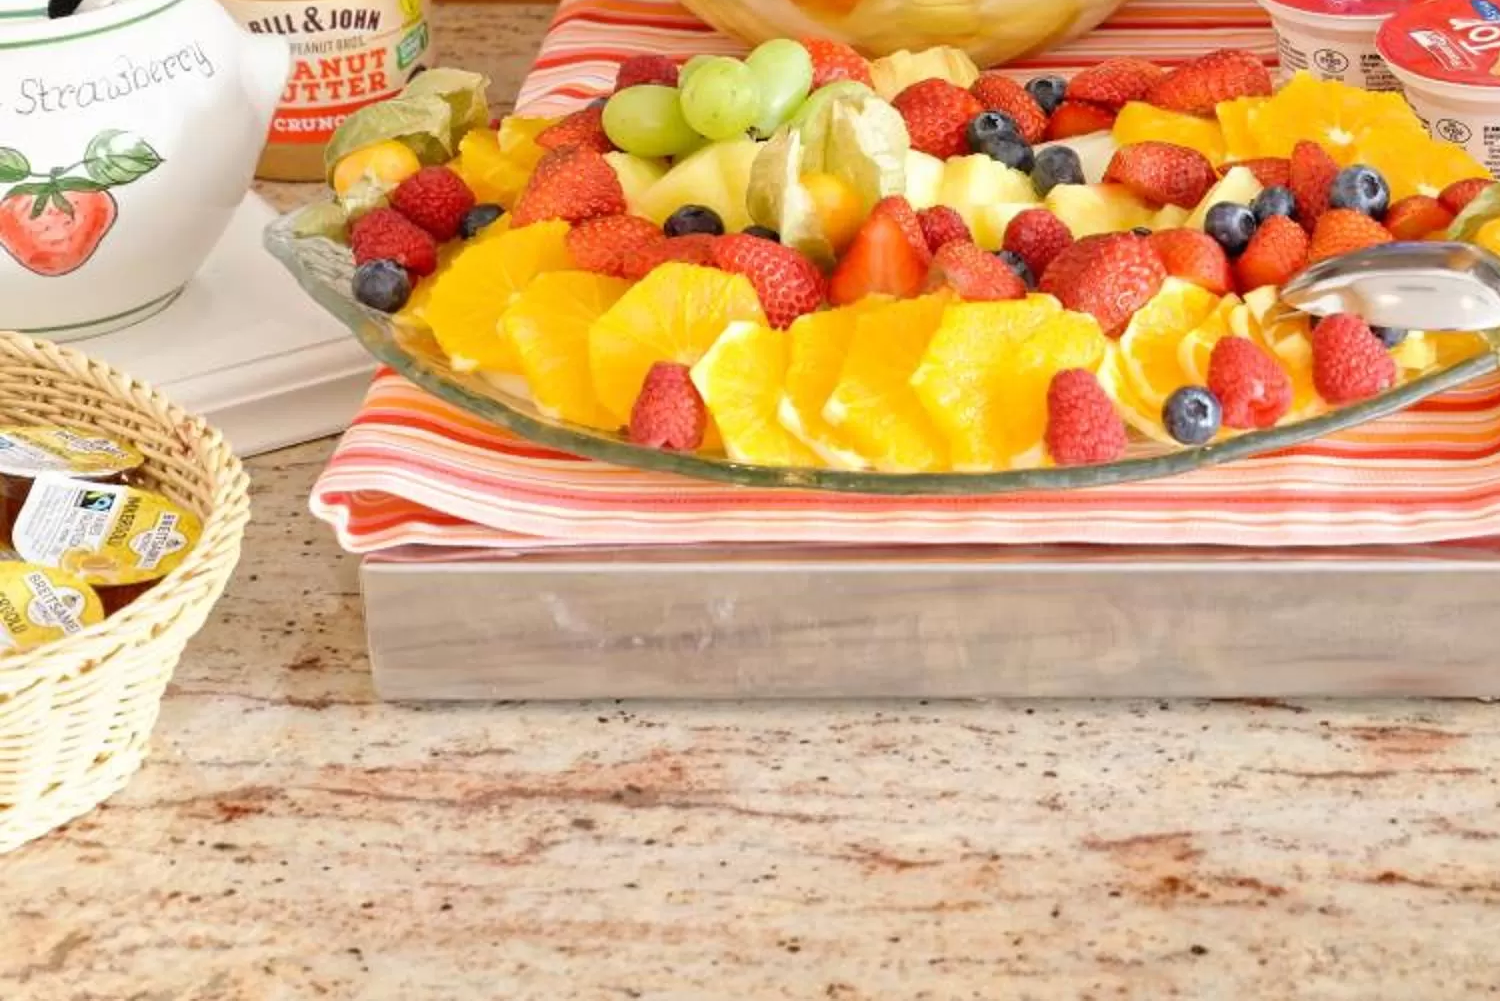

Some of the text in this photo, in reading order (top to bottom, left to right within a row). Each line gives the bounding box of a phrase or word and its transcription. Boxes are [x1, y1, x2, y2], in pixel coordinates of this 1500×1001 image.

[303, 6, 325, 33] &
[329, 7, 382, 31] JOHN
[14, 39, 216, 116] Strawberry
[292, 46, 388, 81] ANUT
[281, 70, 388, 103] UTTER
[273, 114, 346, 133] CRUNC
